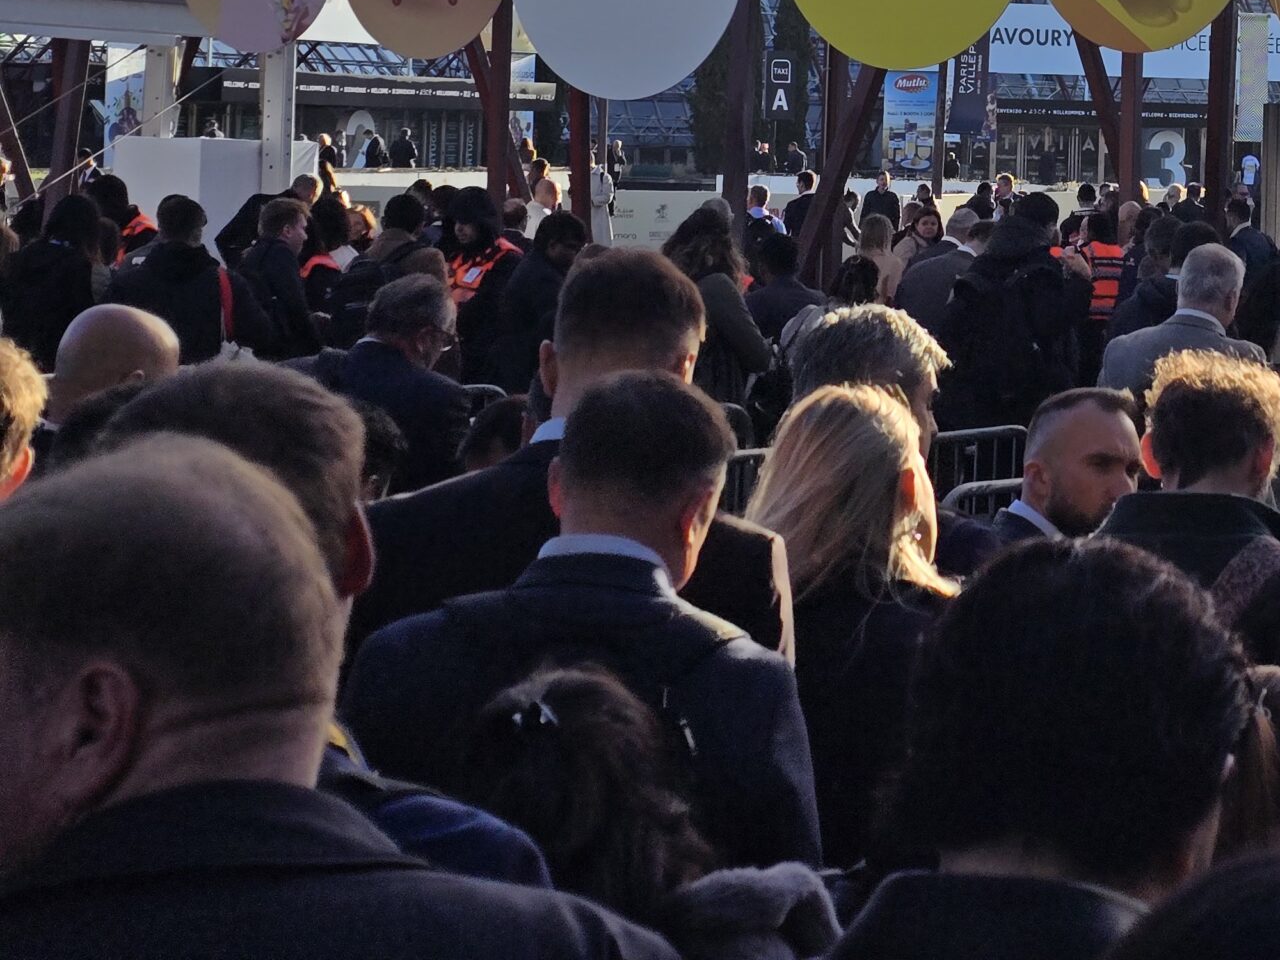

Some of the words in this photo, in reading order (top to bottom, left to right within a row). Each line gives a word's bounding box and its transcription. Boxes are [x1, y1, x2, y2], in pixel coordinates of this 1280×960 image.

[990, 28, 1073, 47] AVOURY
[773, 67, 789, 75] TAXI
[958, 54, 969, 94] PARIS
[966, 42, 978, 94] VILLEP
[772, 88, 789, 111] A
[996, 107, 1022, 115] ENVENIDO
[1141, 111, 1164, 119] WELCOME
[1146, 129, 1187, 190] 3
